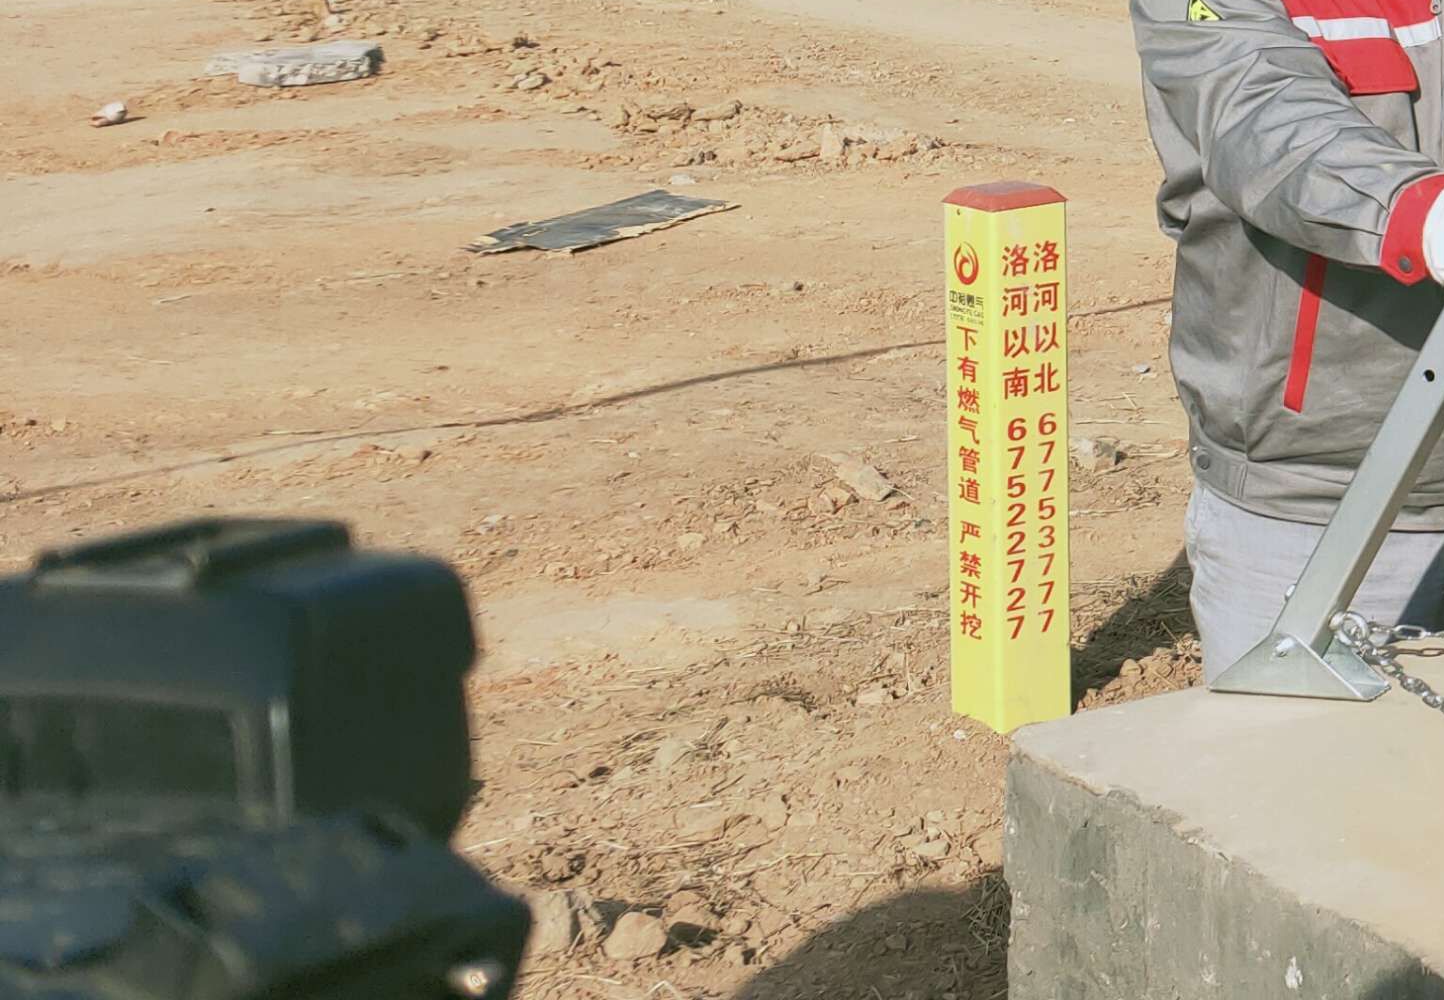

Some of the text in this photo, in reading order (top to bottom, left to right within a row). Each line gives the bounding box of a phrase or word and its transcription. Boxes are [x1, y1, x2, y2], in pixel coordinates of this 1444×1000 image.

[956, 326, 981, 504] 下有燃气管道
[1002, 244, 1030, 640] 洛河以南 67522727
[1033, 240, 1060, 633] 洛河以北 67753777
[959, 520, 983, 640] 严禁开挖
